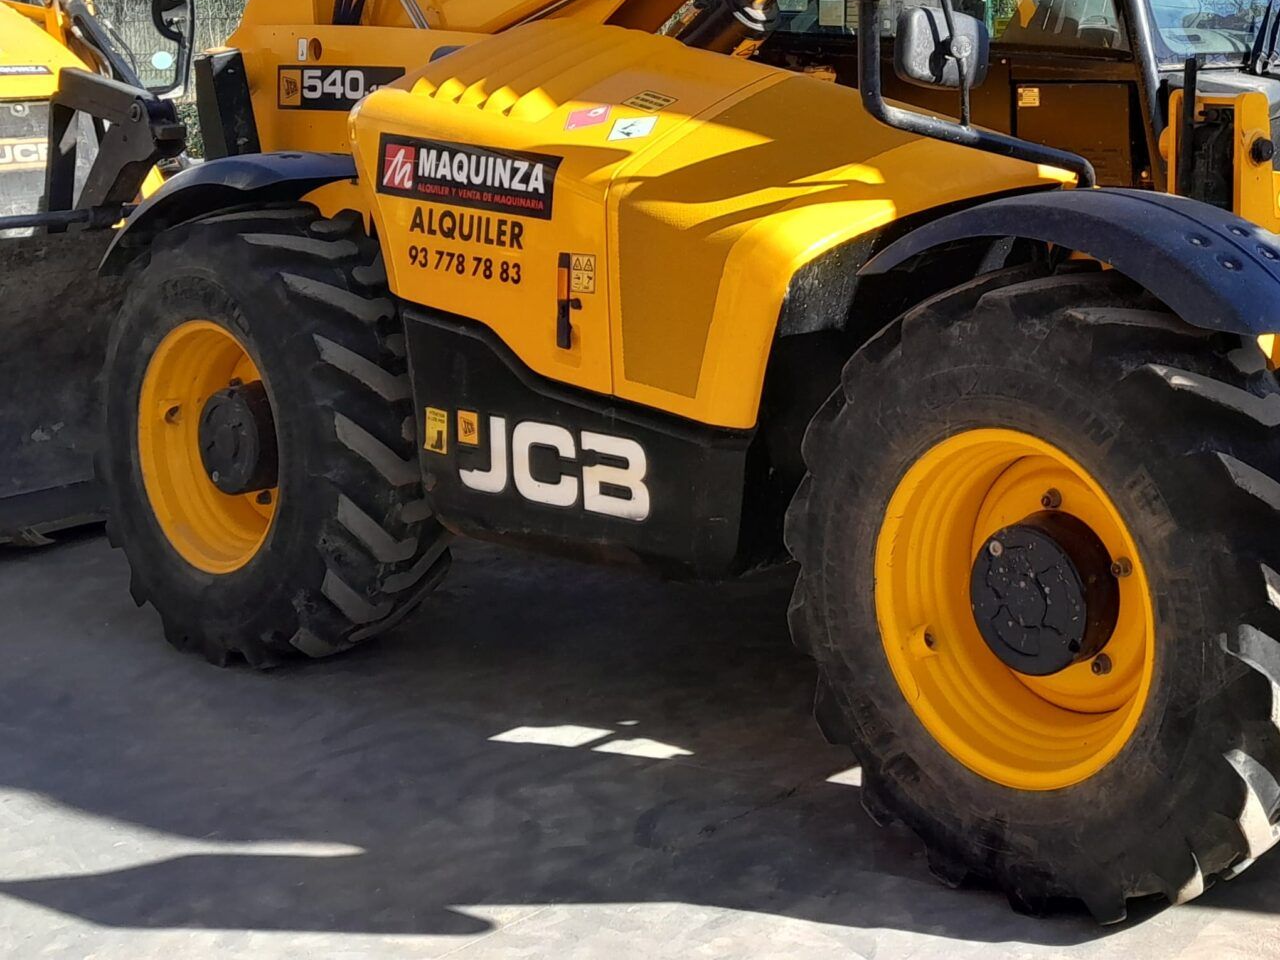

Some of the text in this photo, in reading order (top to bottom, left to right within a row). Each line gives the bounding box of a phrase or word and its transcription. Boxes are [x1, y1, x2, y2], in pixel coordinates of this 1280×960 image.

[417, 147, 545, 194] MAQUINZA
[417, 182, 450, 196] ALQUILER
[458, 189, 481, 201] VENTA
[482, 192, 493, 202] DE
[494, 194, 545, 211] MAQUINARIA
[409, 206, 524, 250] ALQUILER
[408, 245, 522, 285] 93 778 78 83
[459, 415, 650, 522] JCB
